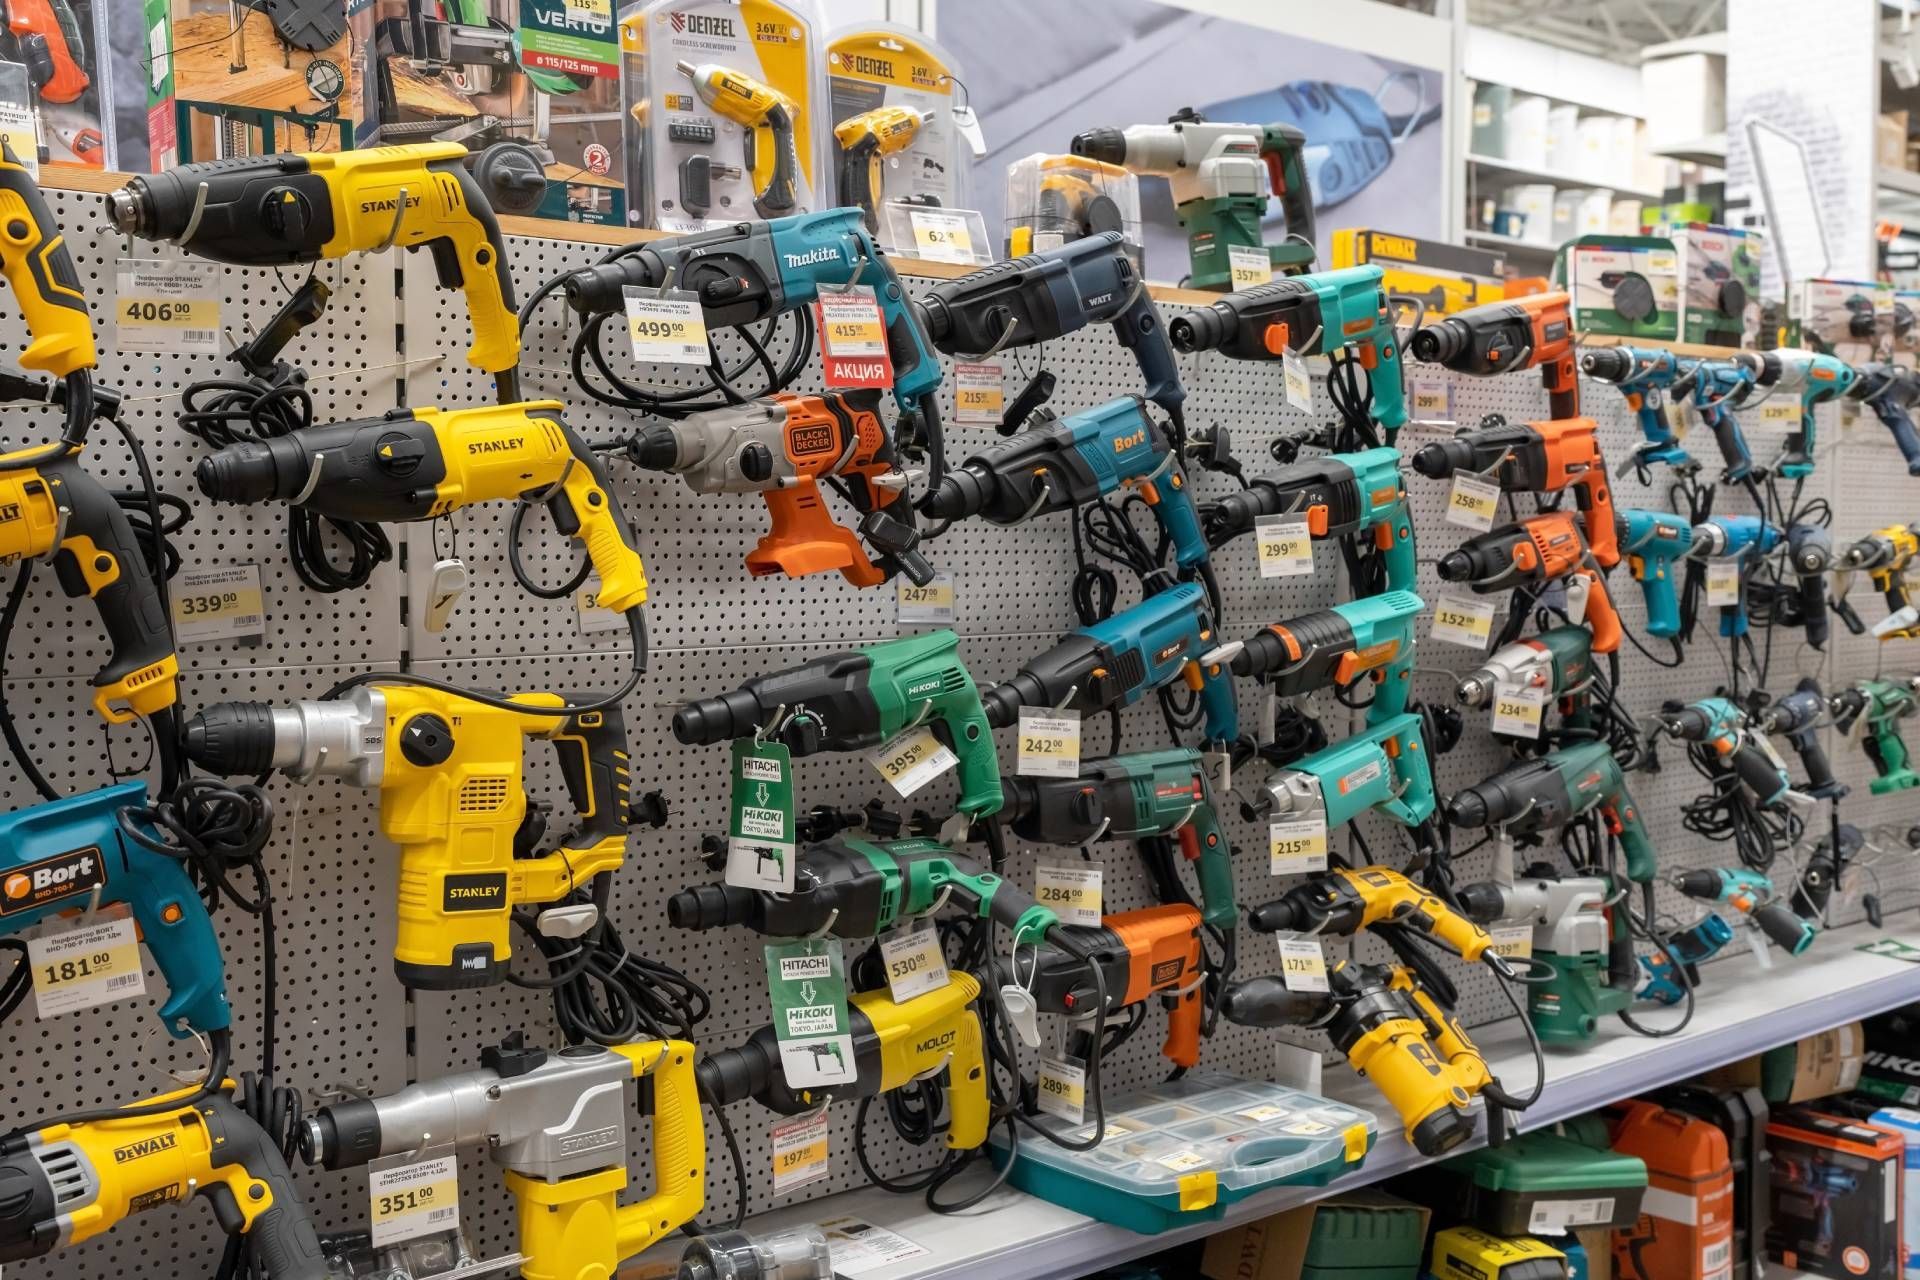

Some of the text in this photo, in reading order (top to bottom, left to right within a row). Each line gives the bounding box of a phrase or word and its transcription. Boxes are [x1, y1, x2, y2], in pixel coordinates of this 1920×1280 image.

[688, 14, 736, 38] DENZEL
[756, 22, 776, 34] 3.6V
[699, 40, 737, 52] SCREWDRIVER
[544, 57, 579, 71] 115/125
[580, 62, 598, 74] mm
[856, 55, 895, 79] DENZEL
[912, 65, 927, 78] 3.6V
[592, 151, 602, 167] 2
[361, 196, 421, 213] STANEY
[1088, 293, 1112, 307] WATT
[126, 302, 190, 322] 406 00
[637, 322, 684, 337] 499 00
[835, 324, 857, 337] 415
[833, 361, 886, 382] АКЦИЯ
[964, 391, 981, 403] 215
[468, 437, 524, 455] STANLEY
[796, 438, 830, 450] DECKER
[1114, 429, 1145, 453] Bort
[1455, 493, 1475, 508] 258
[0, 505, 19, 520] LT
[1265, 543, 1288, 557] 299
[221, 569, 247, 577] STANLEY
[904, 588, 928, 601] 247
[182, 592, 237, 615] 339 00
[1441, 611, 1465, 627] 152
[1500, 703, 1520, 716] 234
[1025, 738, 1052, 753] 242
[744, 759, 780, 773] HITACHI
[886, 750, 917, 776] 395
[743, 825, 781, 836] TOKYO, JAPAN
[1277, 840, 1301, 855] 215
[33, 856, 94, 890] Bort
[449, 886, 500, 899] STANLEY
[1041, 887, 1071, 902] 284
[51, 925, 114, 946] Перфоратор BORT
[107, 931, 122, 940] 3Дж
[44, 952, 110, 985] 181 00
[782, 958, 829, 971] HITACHI
[891, 957, 917, 977] 530
[1287, 959, 1304, 971] 171
[790, 1023, 835, 1034] TOKYO, JAPAN
[916, 1030, 956, 1054] MOLOT
[1042, 1076, 1062, 1095] 289
[562, 1130, 615, 1152] STANLEY
[783, 1150, 803, 1168] 197
[383, 1161, 444, 1180] Перфоратор STANLEY
[379, 1186, 433, 1215] 351 00
